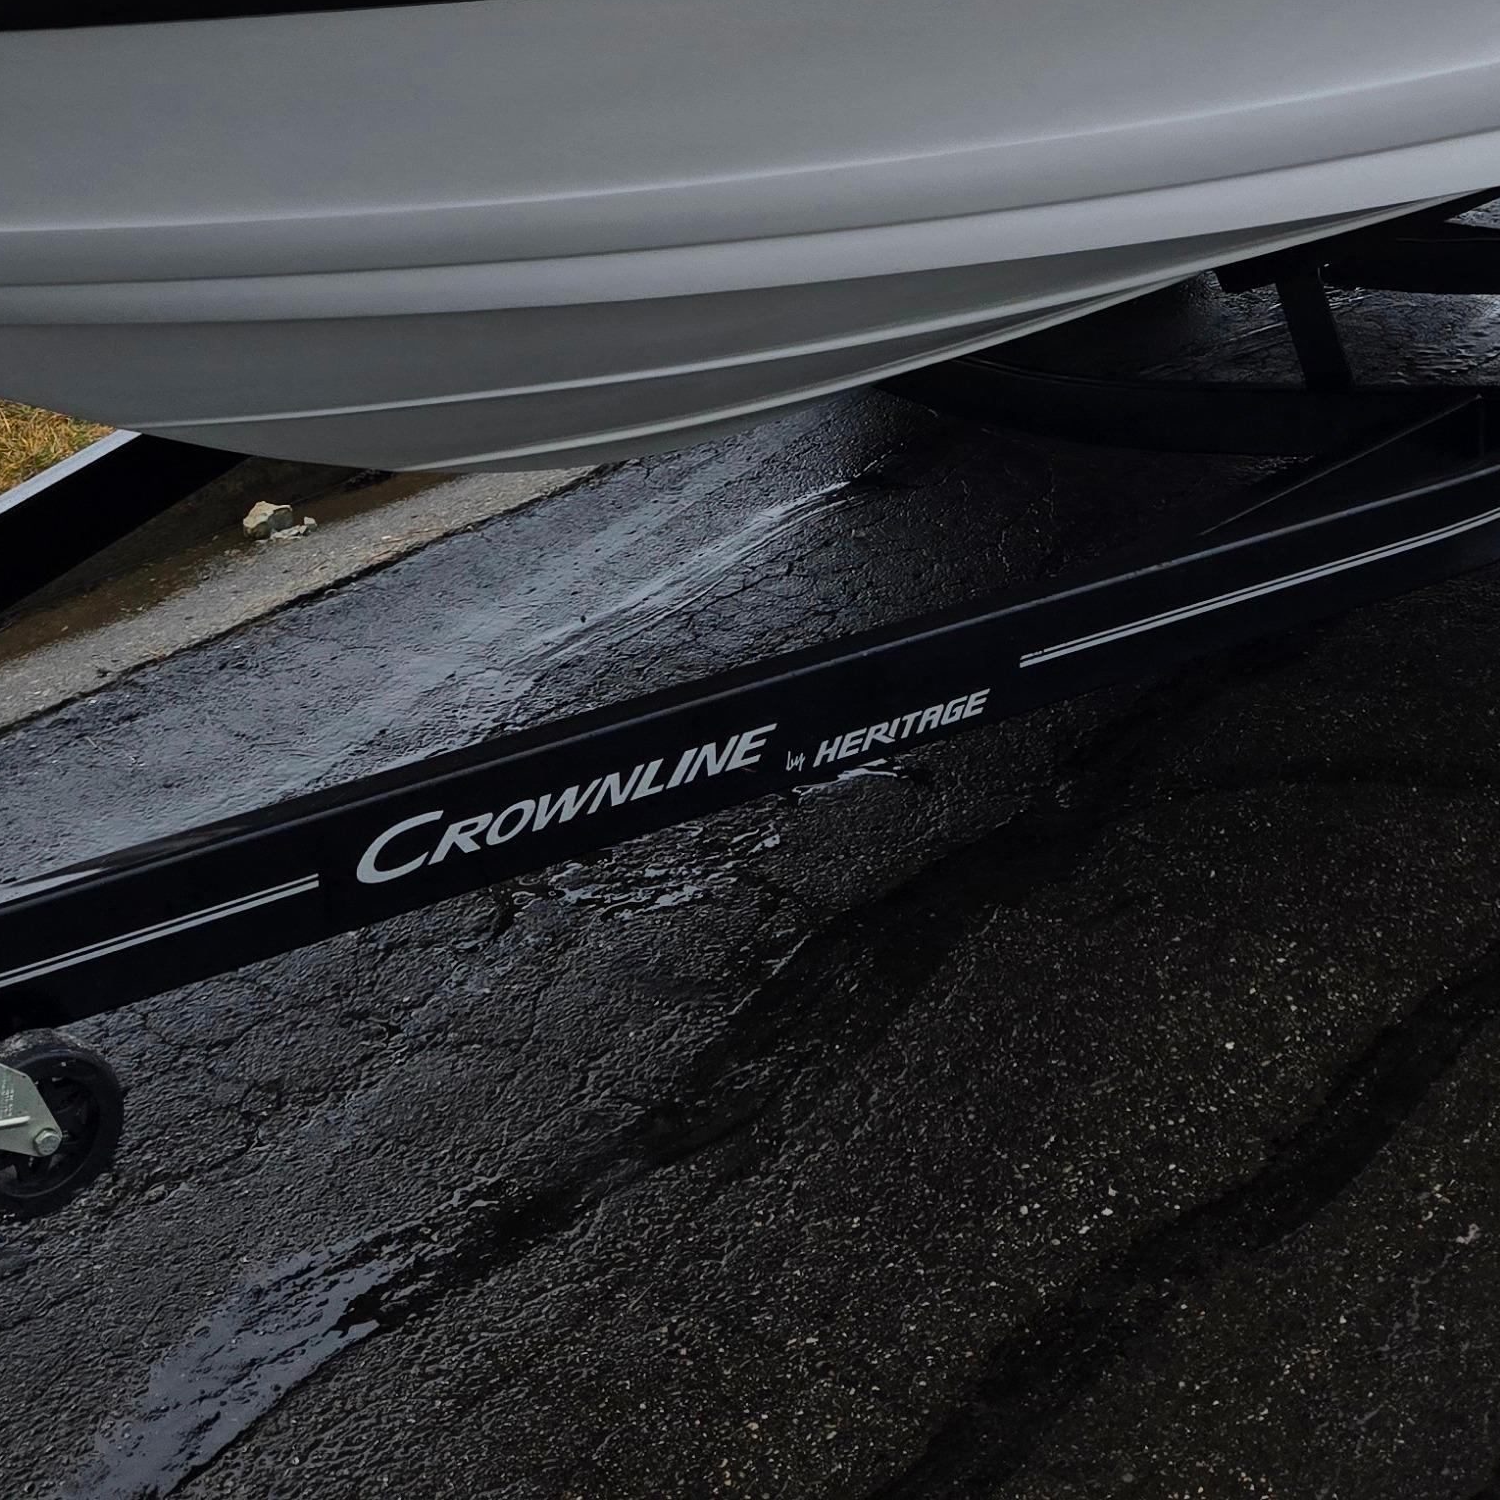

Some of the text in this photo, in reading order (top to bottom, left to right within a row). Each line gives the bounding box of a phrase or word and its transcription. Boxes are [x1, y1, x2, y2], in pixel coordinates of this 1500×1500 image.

[356, 688, 991, 885] CROWNLINE by HERITAGE
